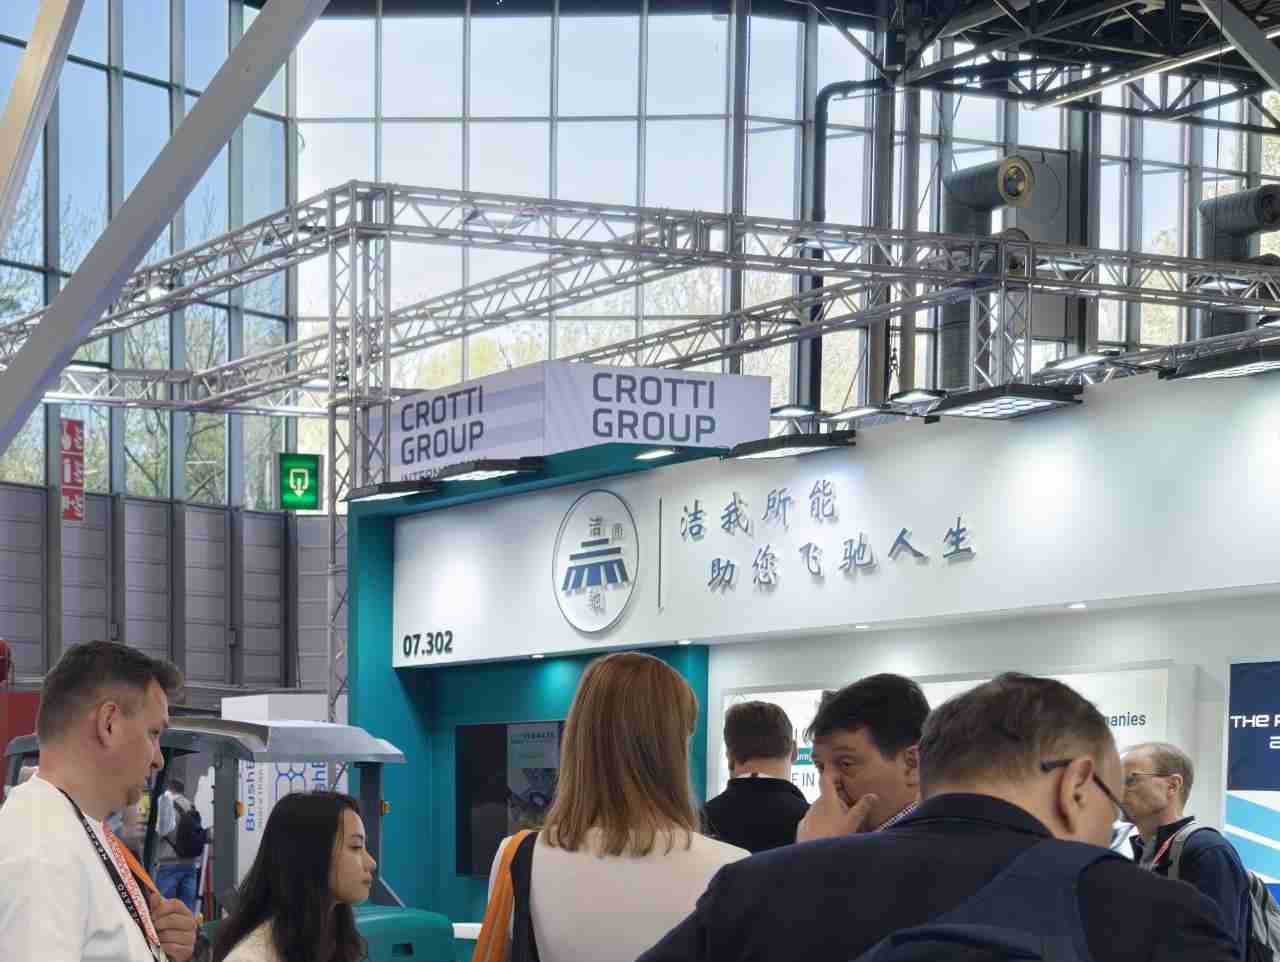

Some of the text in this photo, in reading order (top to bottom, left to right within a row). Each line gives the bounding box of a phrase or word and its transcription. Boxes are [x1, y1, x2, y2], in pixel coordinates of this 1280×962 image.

[401, 384, 483, 432] CROTTI
[593, 372, 716, 409] CROTTI
[401, 420, 484, 465] GROUP
[593, 408, 717, 443] GROUP
[680, 480, 836, 542] 洁我所能
[707, 516, 974, 590] 助您飞驰人生
[402, 629, 454, 657] 07.302
[1104, 711, 1147, 727] anies
[1230, 714, 1270, 728] THE
